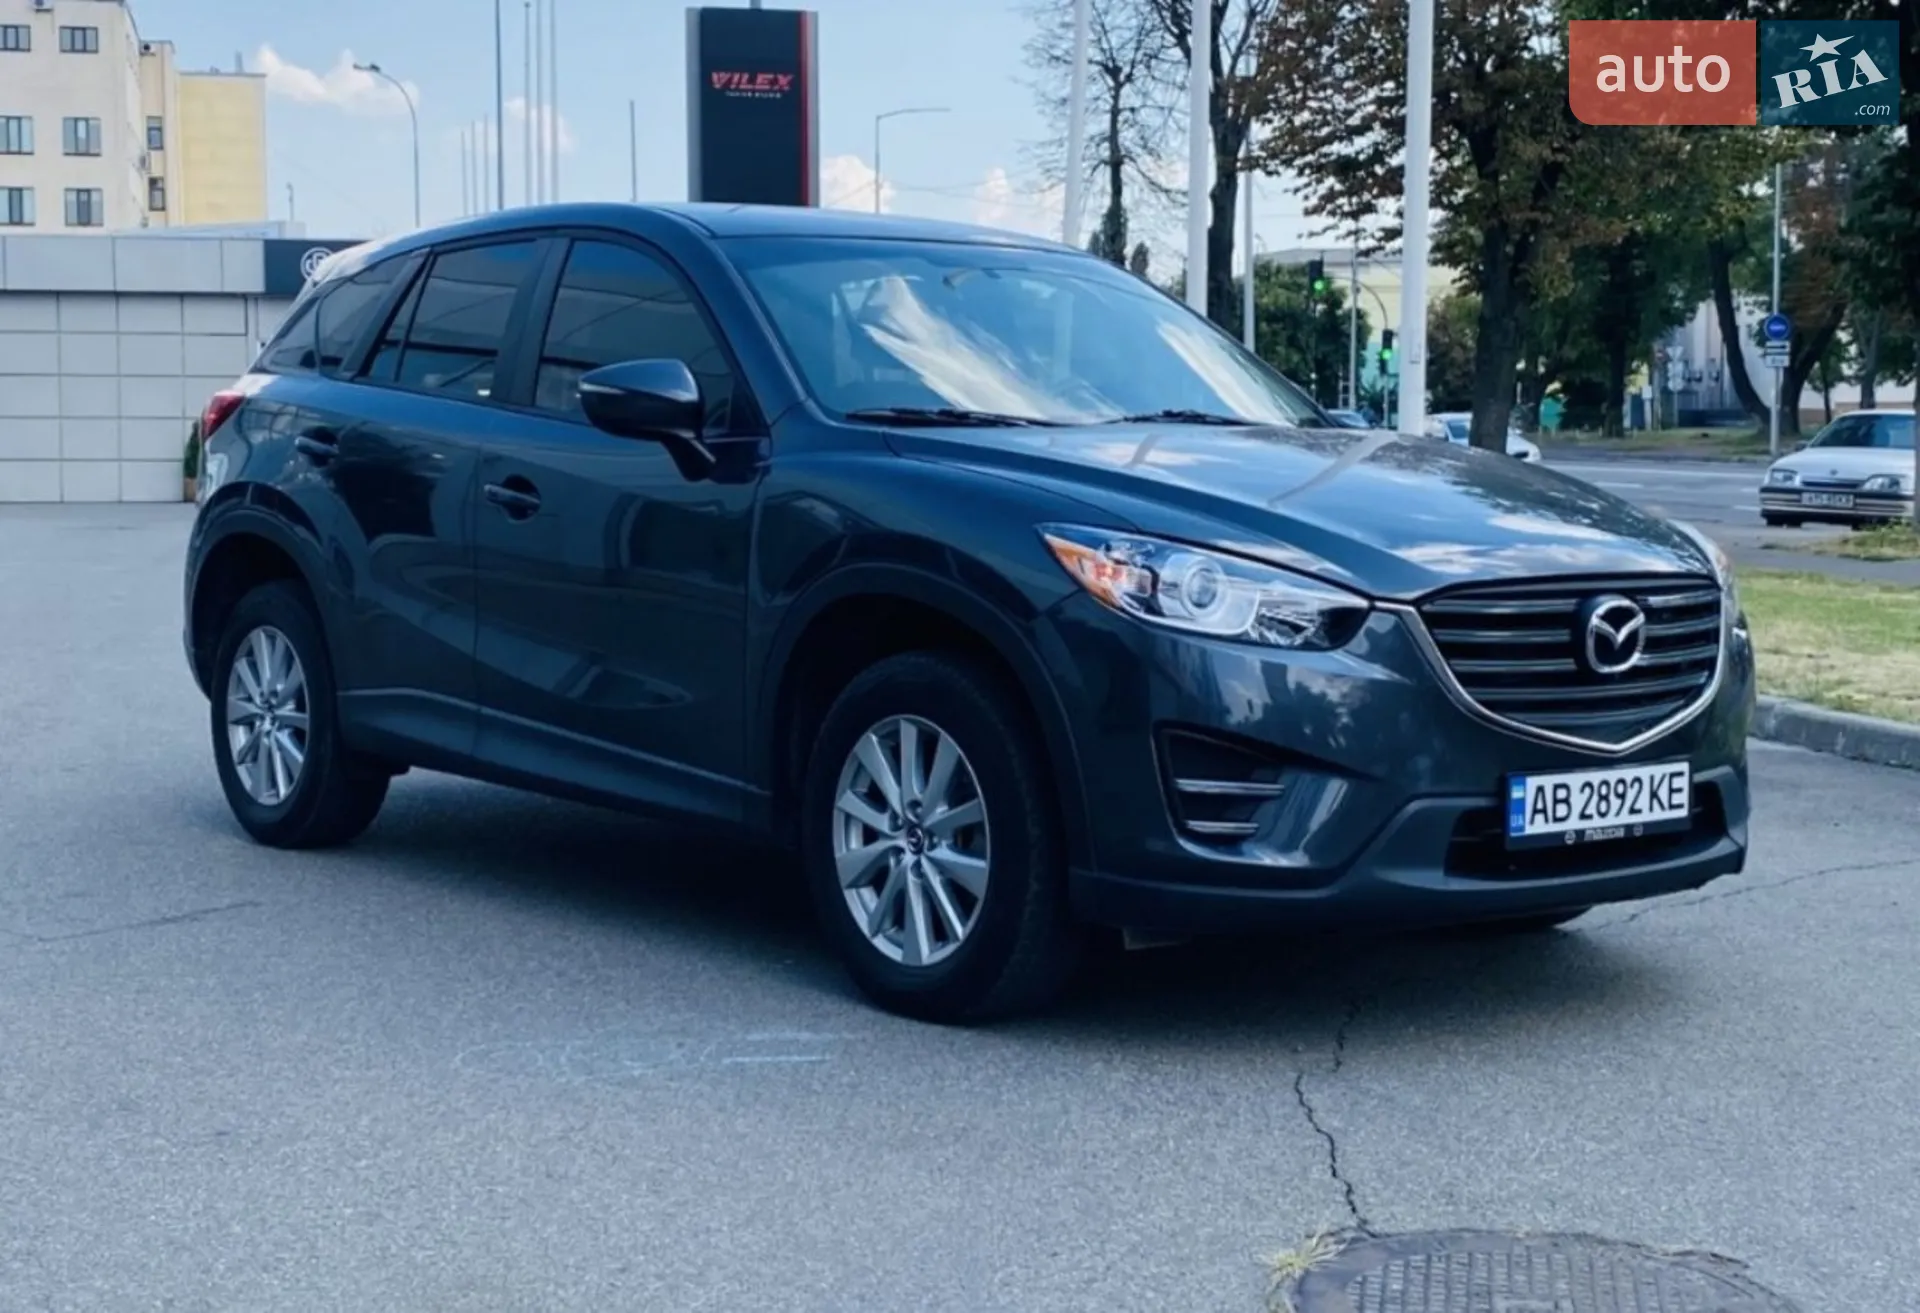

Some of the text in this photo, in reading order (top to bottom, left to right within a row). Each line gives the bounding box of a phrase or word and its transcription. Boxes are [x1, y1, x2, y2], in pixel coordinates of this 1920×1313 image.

[711, 71, 794, 91] VILEX
[1529, 771, 1686, 826] AB 2892 KE
[1510, 814, 1525, 827] UA
